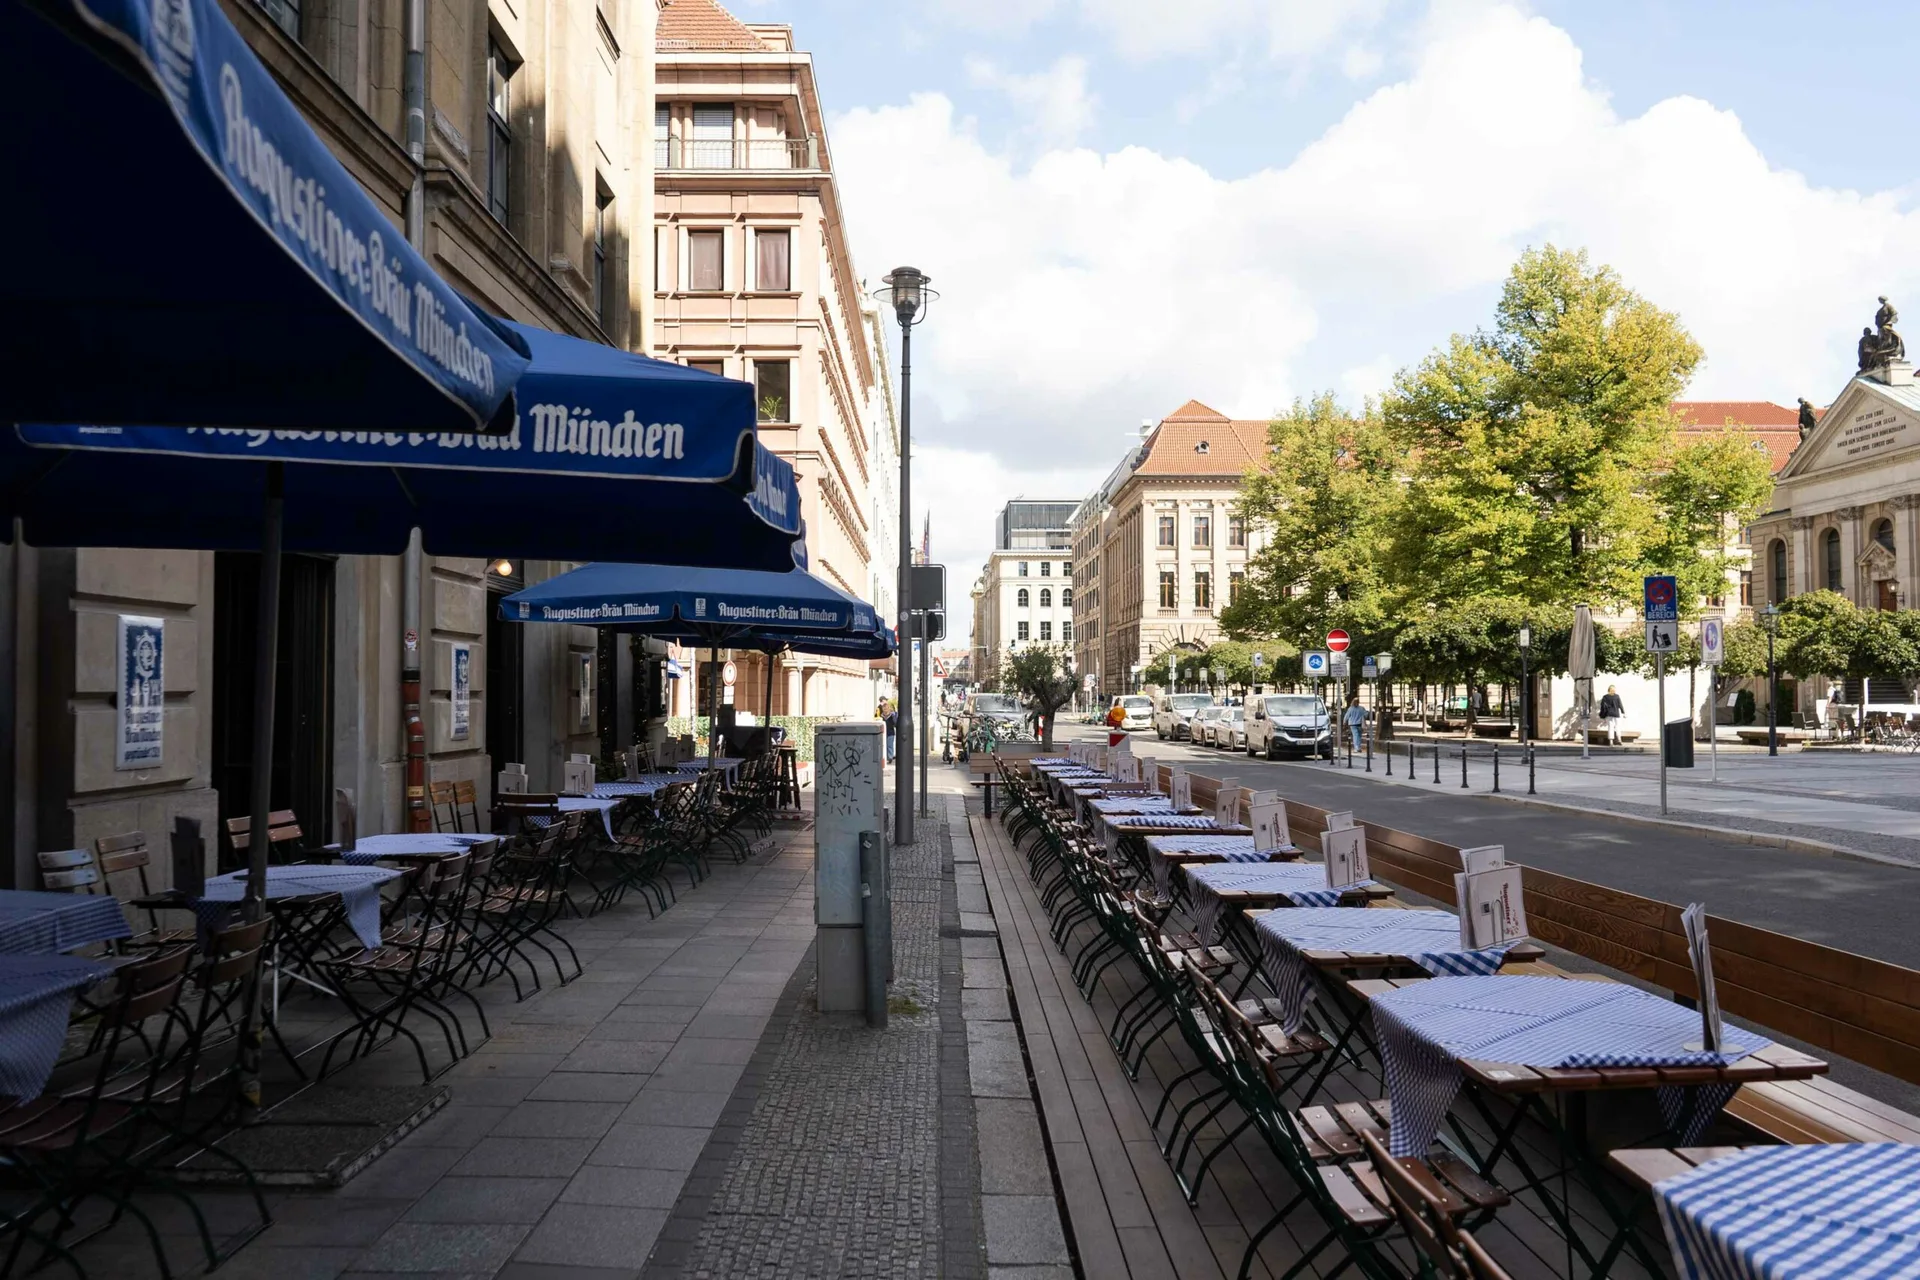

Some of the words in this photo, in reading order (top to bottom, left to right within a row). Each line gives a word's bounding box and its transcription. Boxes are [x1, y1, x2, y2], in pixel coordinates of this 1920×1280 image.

[414, 280, 496, 398] München
[529, 403, 685, 460] München
[624, 603, 660, 616] München
[800, 607, 838, 622] München
[1647, 611, 1675, 619] BEREICH
[1650, 603, 1671, 612] LADE-
[1503, 882, 1511, 925] Augustiner
